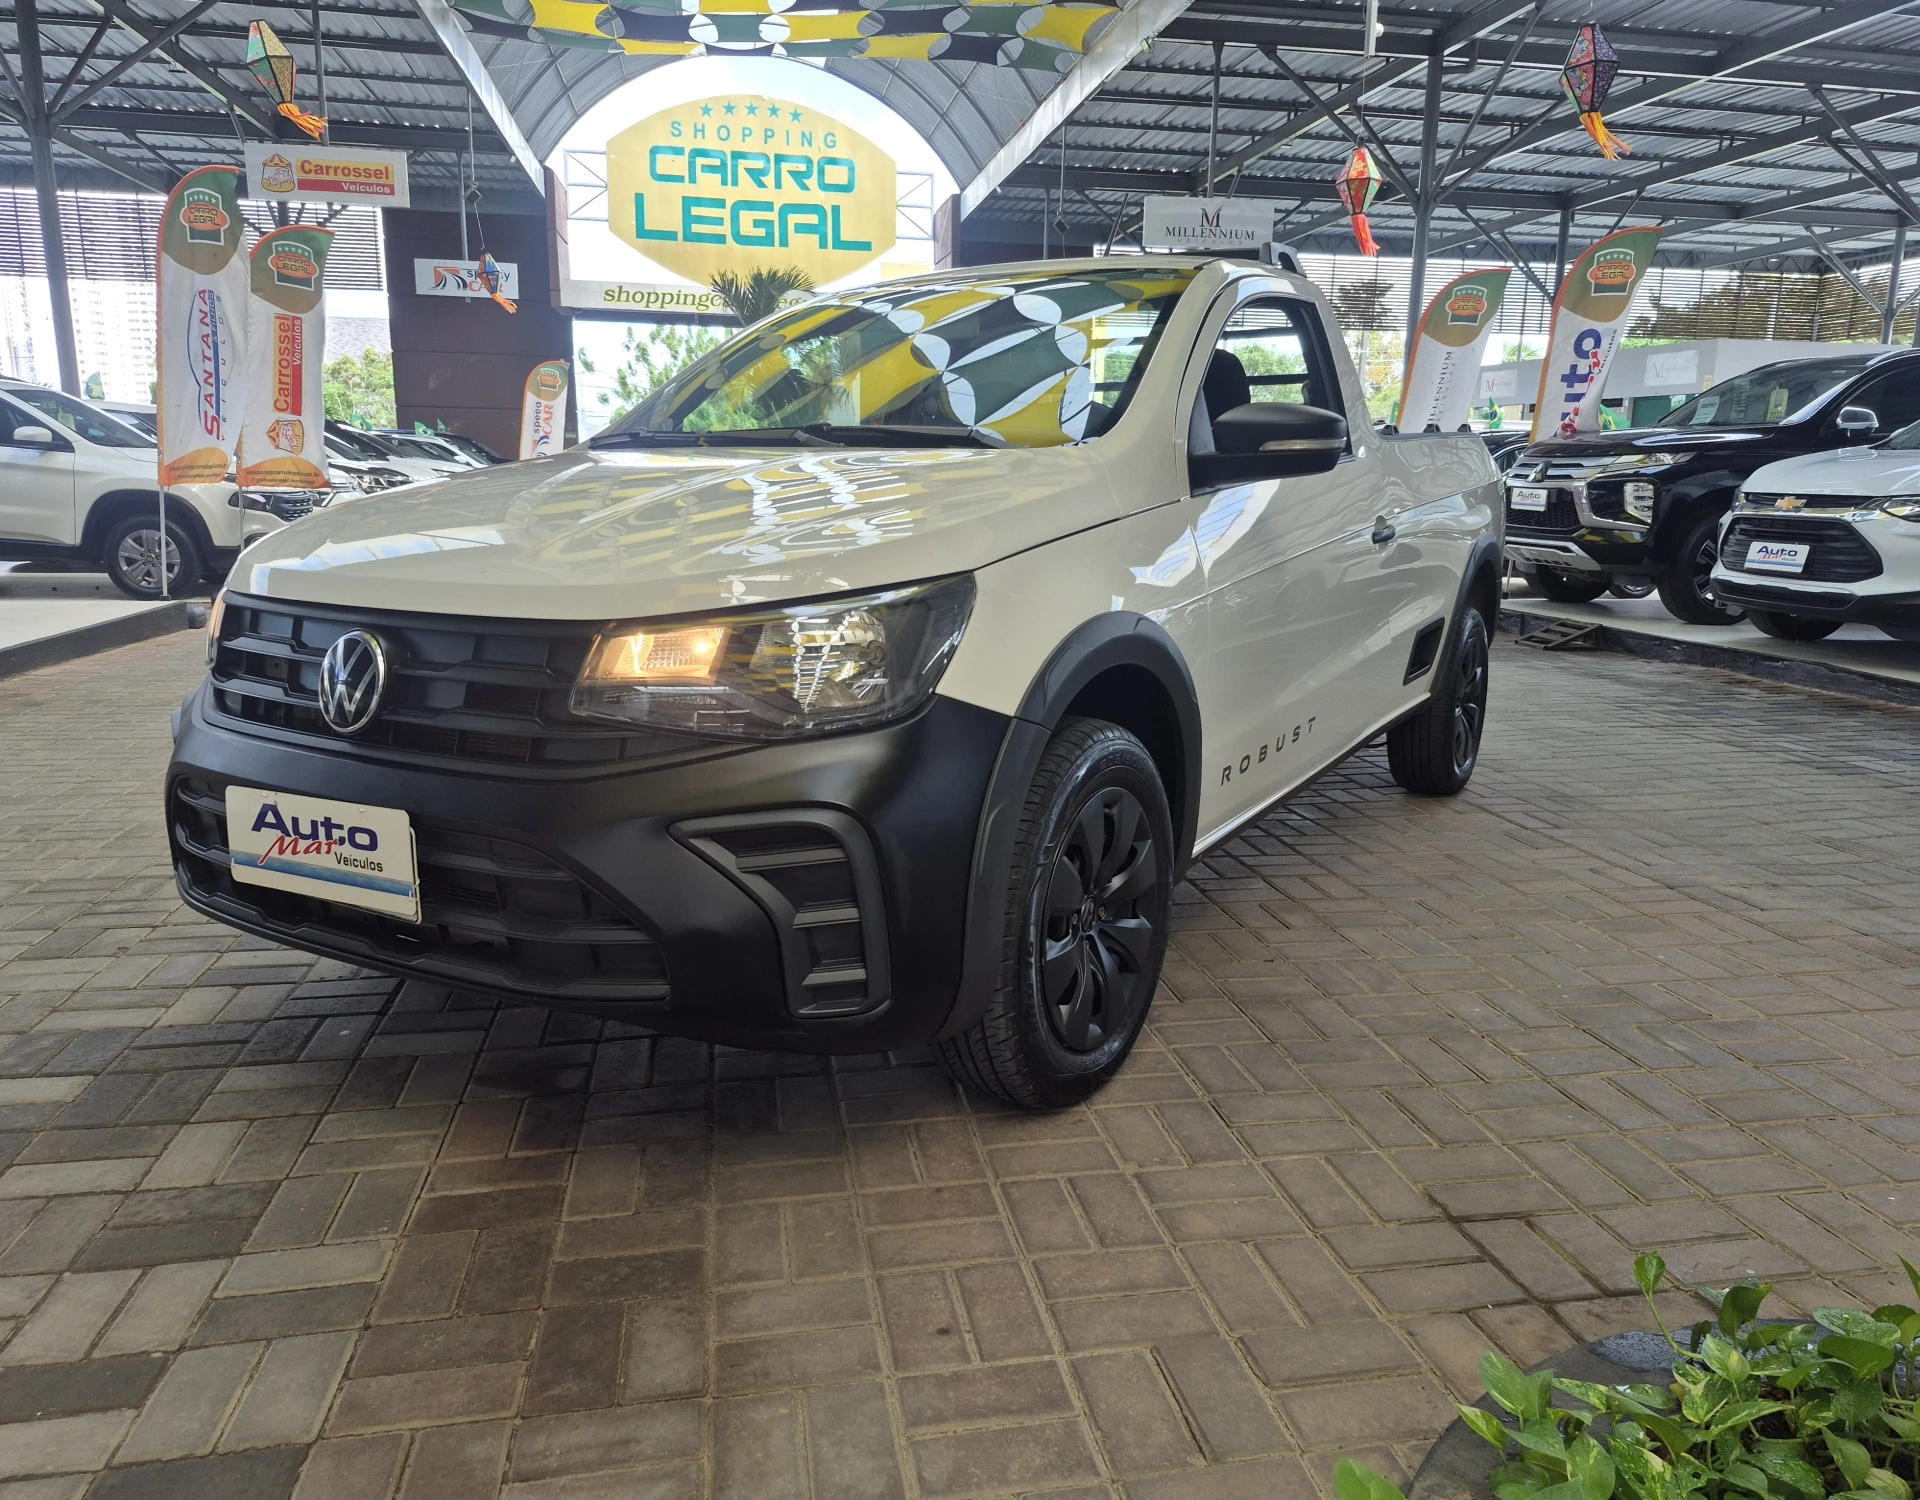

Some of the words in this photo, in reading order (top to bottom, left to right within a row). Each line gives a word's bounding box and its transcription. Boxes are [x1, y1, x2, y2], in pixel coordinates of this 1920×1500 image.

[670, 120, 838, 149] SHOPPING
[300, 159, 390, 180] Carrossel
[648, 144, 856, 194] CARRO
[188, 214, 222, 227] LEGAL
[189, 206, 219, 218] CARRO
[634, 192, 873, 252] LEGAL
[1165, 226, 1255, 241] MILLENNIUM
[276, 263, 312, 275] LEGAL
[277, 255, 311, 266] CARRO
[1597, 264, 1631, 272] CARRO
[1595, 271, 1630, 280] LEGAL
[1450, 304, 1481, 312] LEGAL
[198, 289, 220, 441] SANTANA
[274, 315, 290, 412] Carrossel
[1428, 351, 1453, 422] ILLENNIUM
[1553, 328, 1602, 437] uto
[542, 404, 553, 436] CAR
[1517, 490, 1541, 499] Auto
[1757, 545, 1798, 557] Auto
[1221, 716, 1316, 786] ROBUST
[250, 802, 379, 852] Auto
[258, 834, 339, 865] Mar
[334, 851, 384, 873] Veículos
